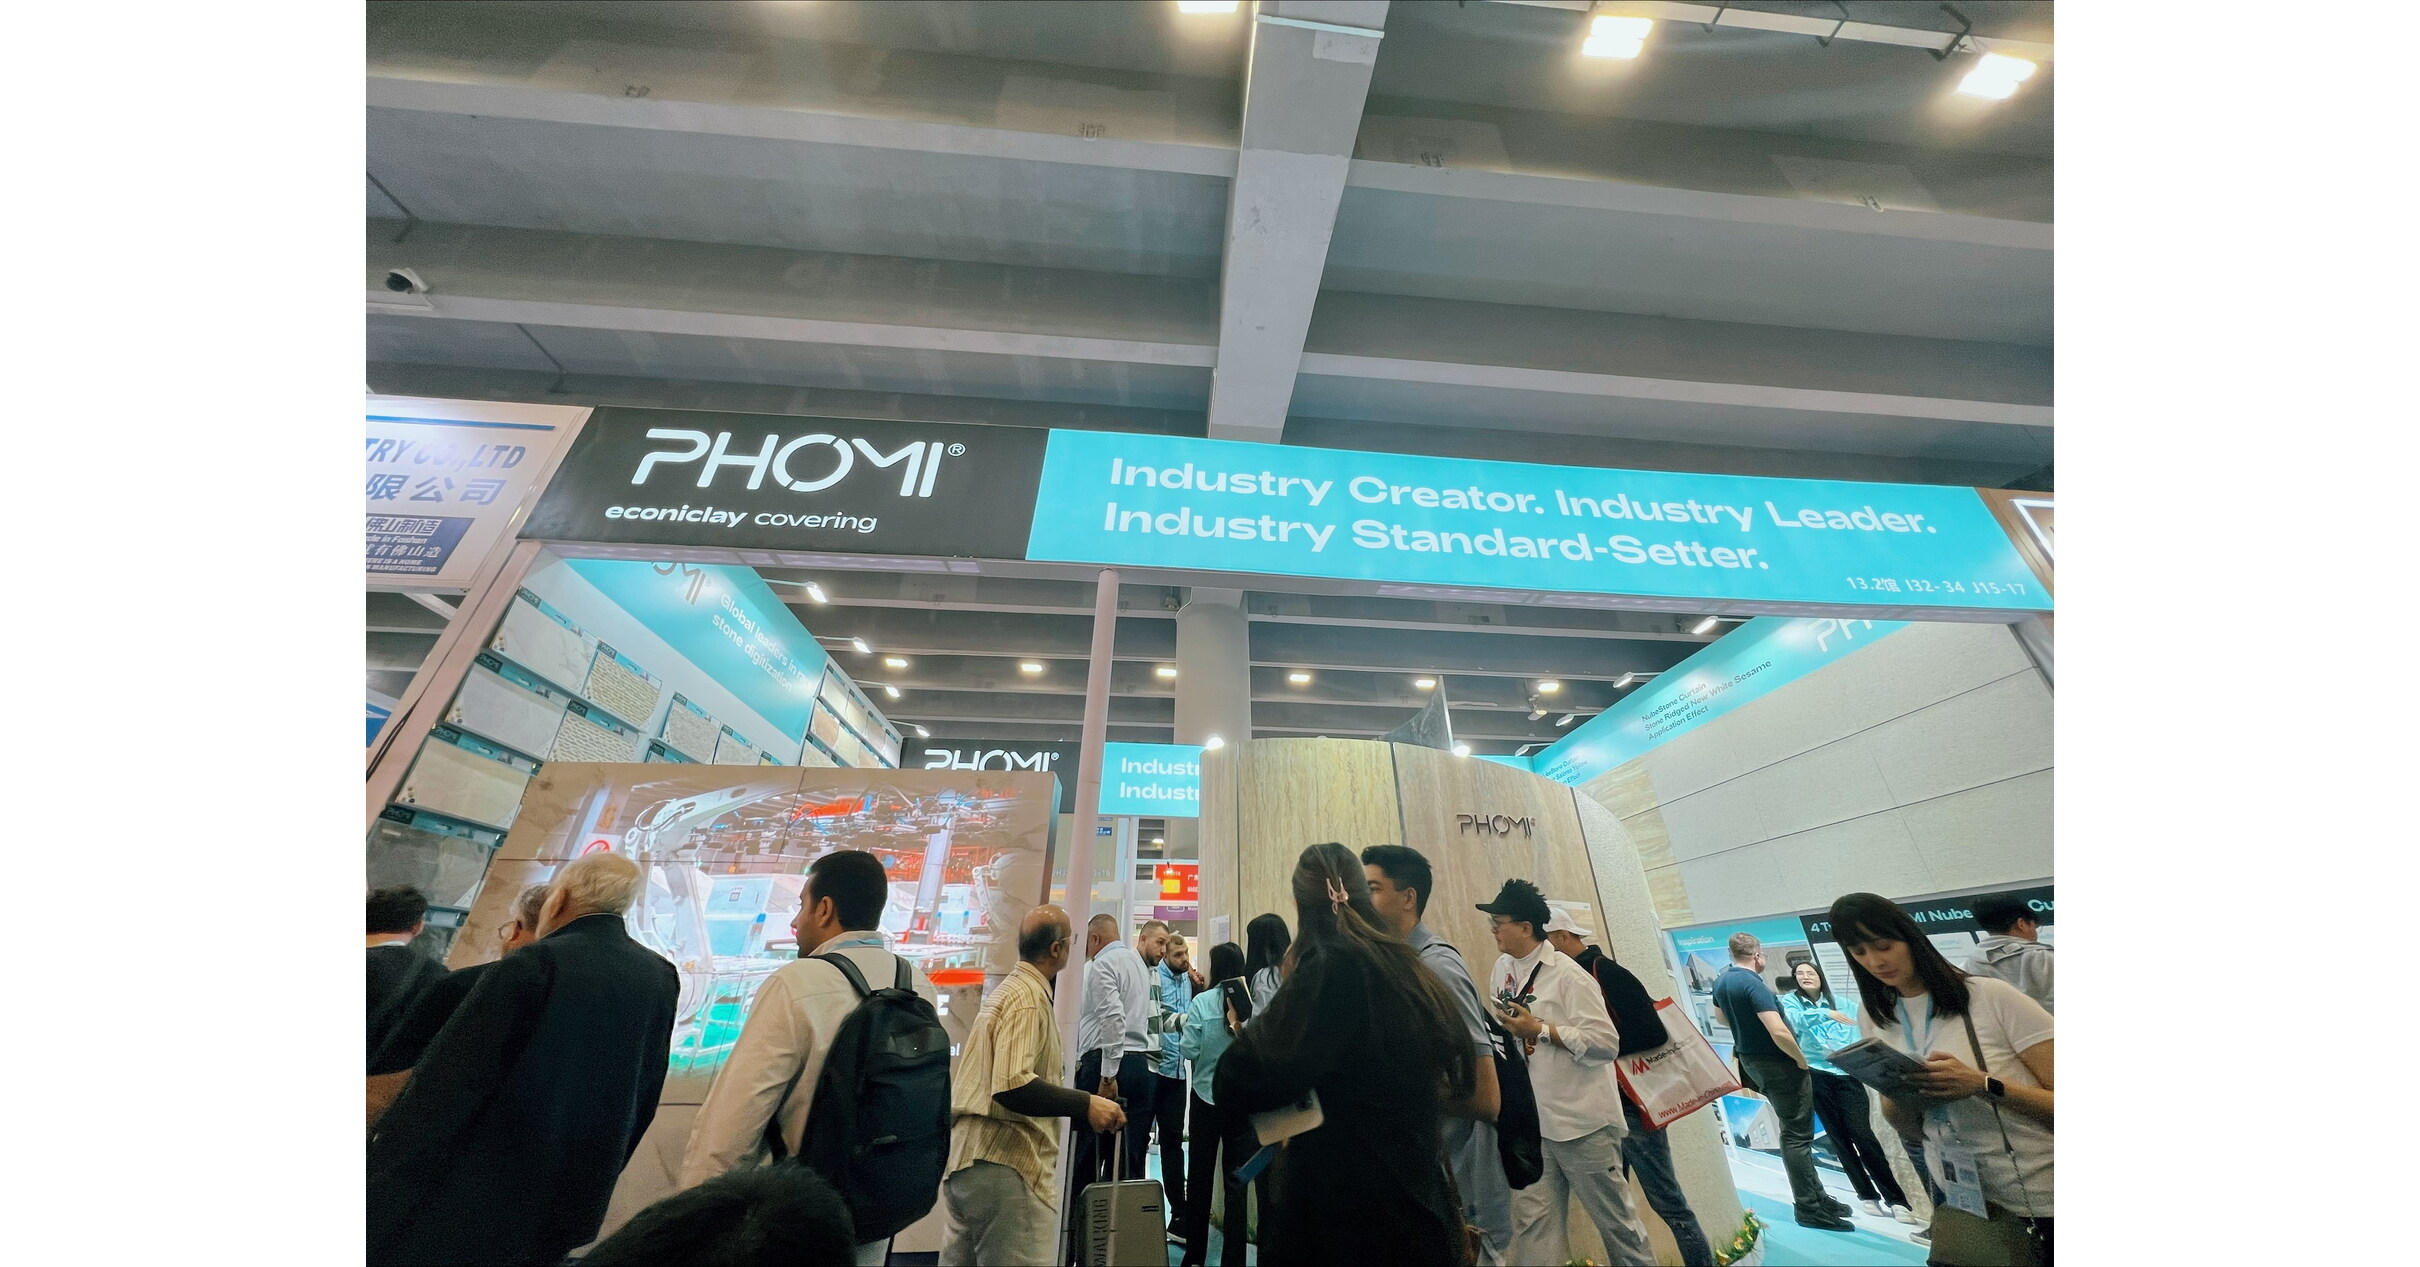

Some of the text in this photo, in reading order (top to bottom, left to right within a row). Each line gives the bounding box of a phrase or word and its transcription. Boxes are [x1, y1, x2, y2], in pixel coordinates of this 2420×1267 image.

[604, 504, 878, 534] econiclay covering
[1110, 457, 1938, 535] Industry Creator. Industry Leader.
[1103, 501, 1770, 570] Industry Standard-Setter.
[712, 614, 793, 693] stone digitization
[720, 594, 756, 633] Global
[755, 625, 788, 663] leaders
[788, 659, 797, 675] in
[1642, 682, 1707, 723] NubeStone Curtain
[1644, 660, 1772, 731] Stone Ridged New White Sesame
[1648, 705, 1709, 741] Application Effect
[1811, 922, 1820, 933] 4
[1927, 908, 1974, 922] Nube
